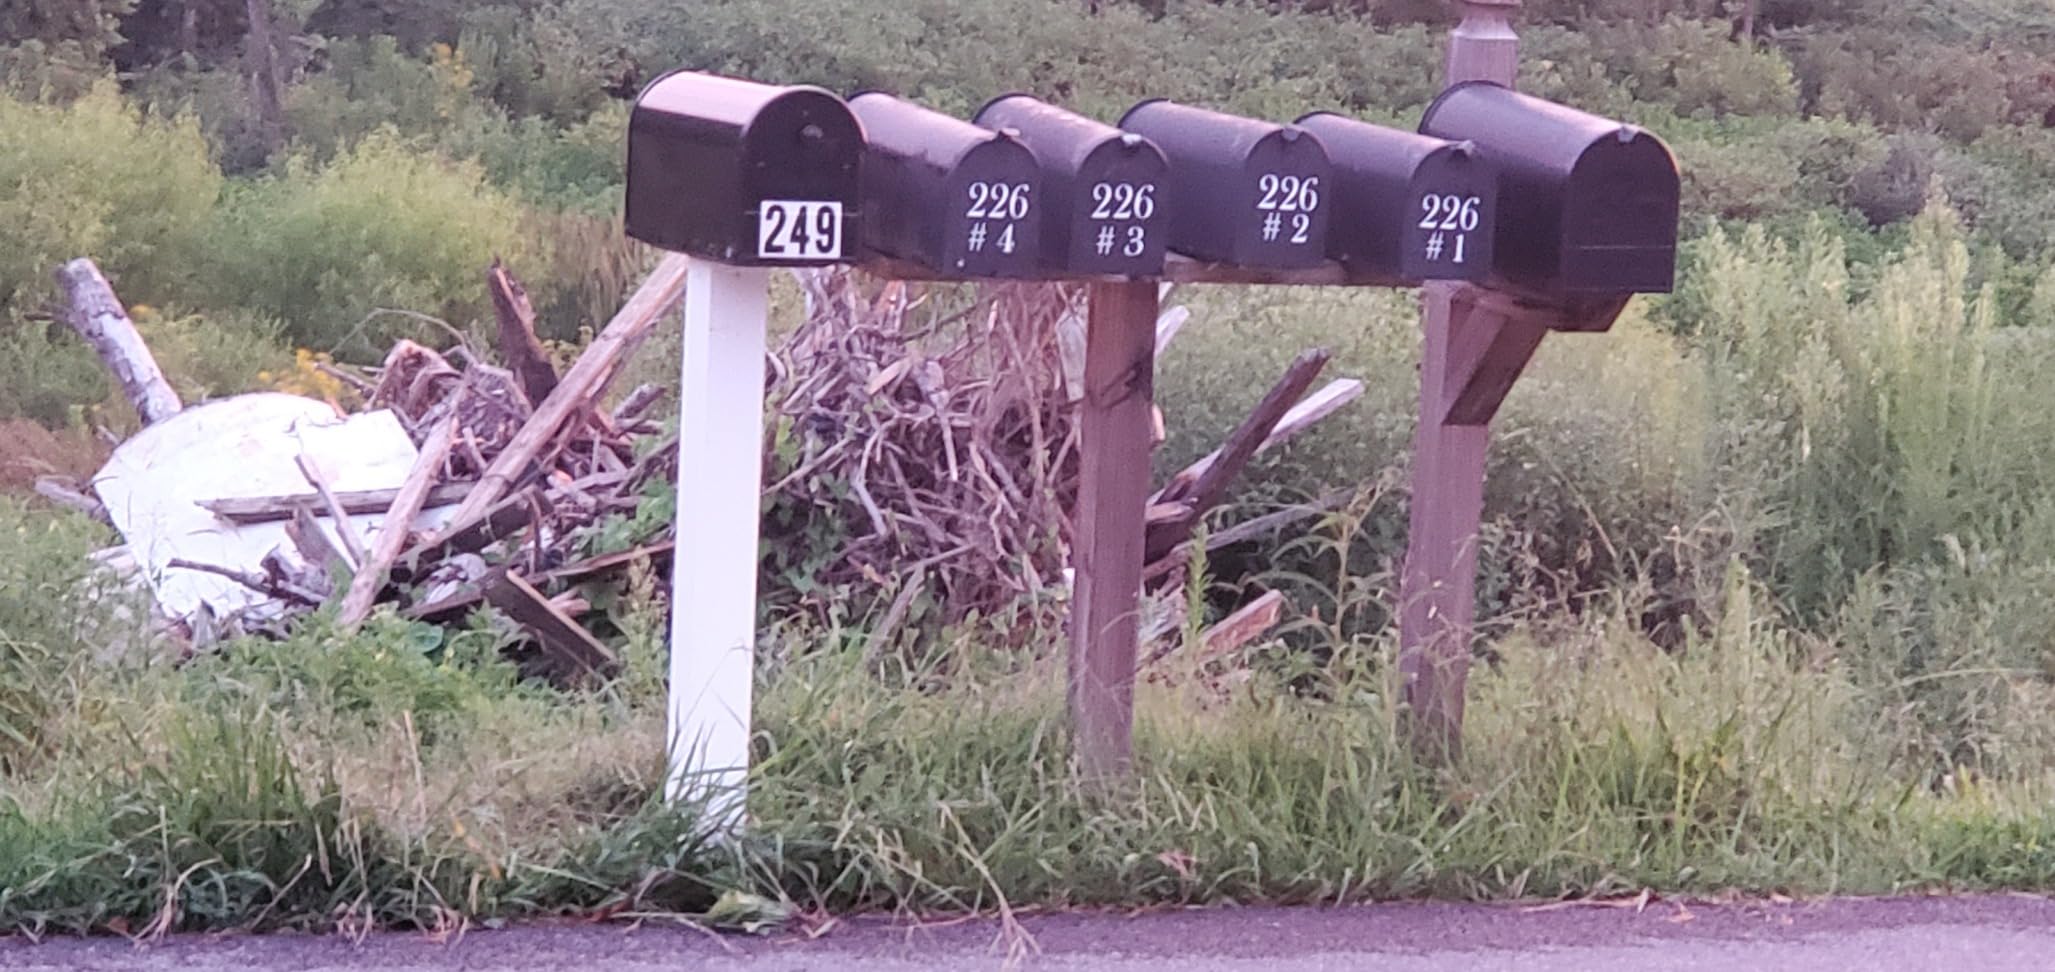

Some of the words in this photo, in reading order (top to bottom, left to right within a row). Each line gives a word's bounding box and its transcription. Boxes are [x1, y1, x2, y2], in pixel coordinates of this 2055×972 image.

[966, 182, 1030, 220] 226
[1090, 183, 1155, 220] 226
[1256, 173, 1319, 212] 226
[764, 204, 836, 254] 249
[1418, 194, 1481, 231] 226
